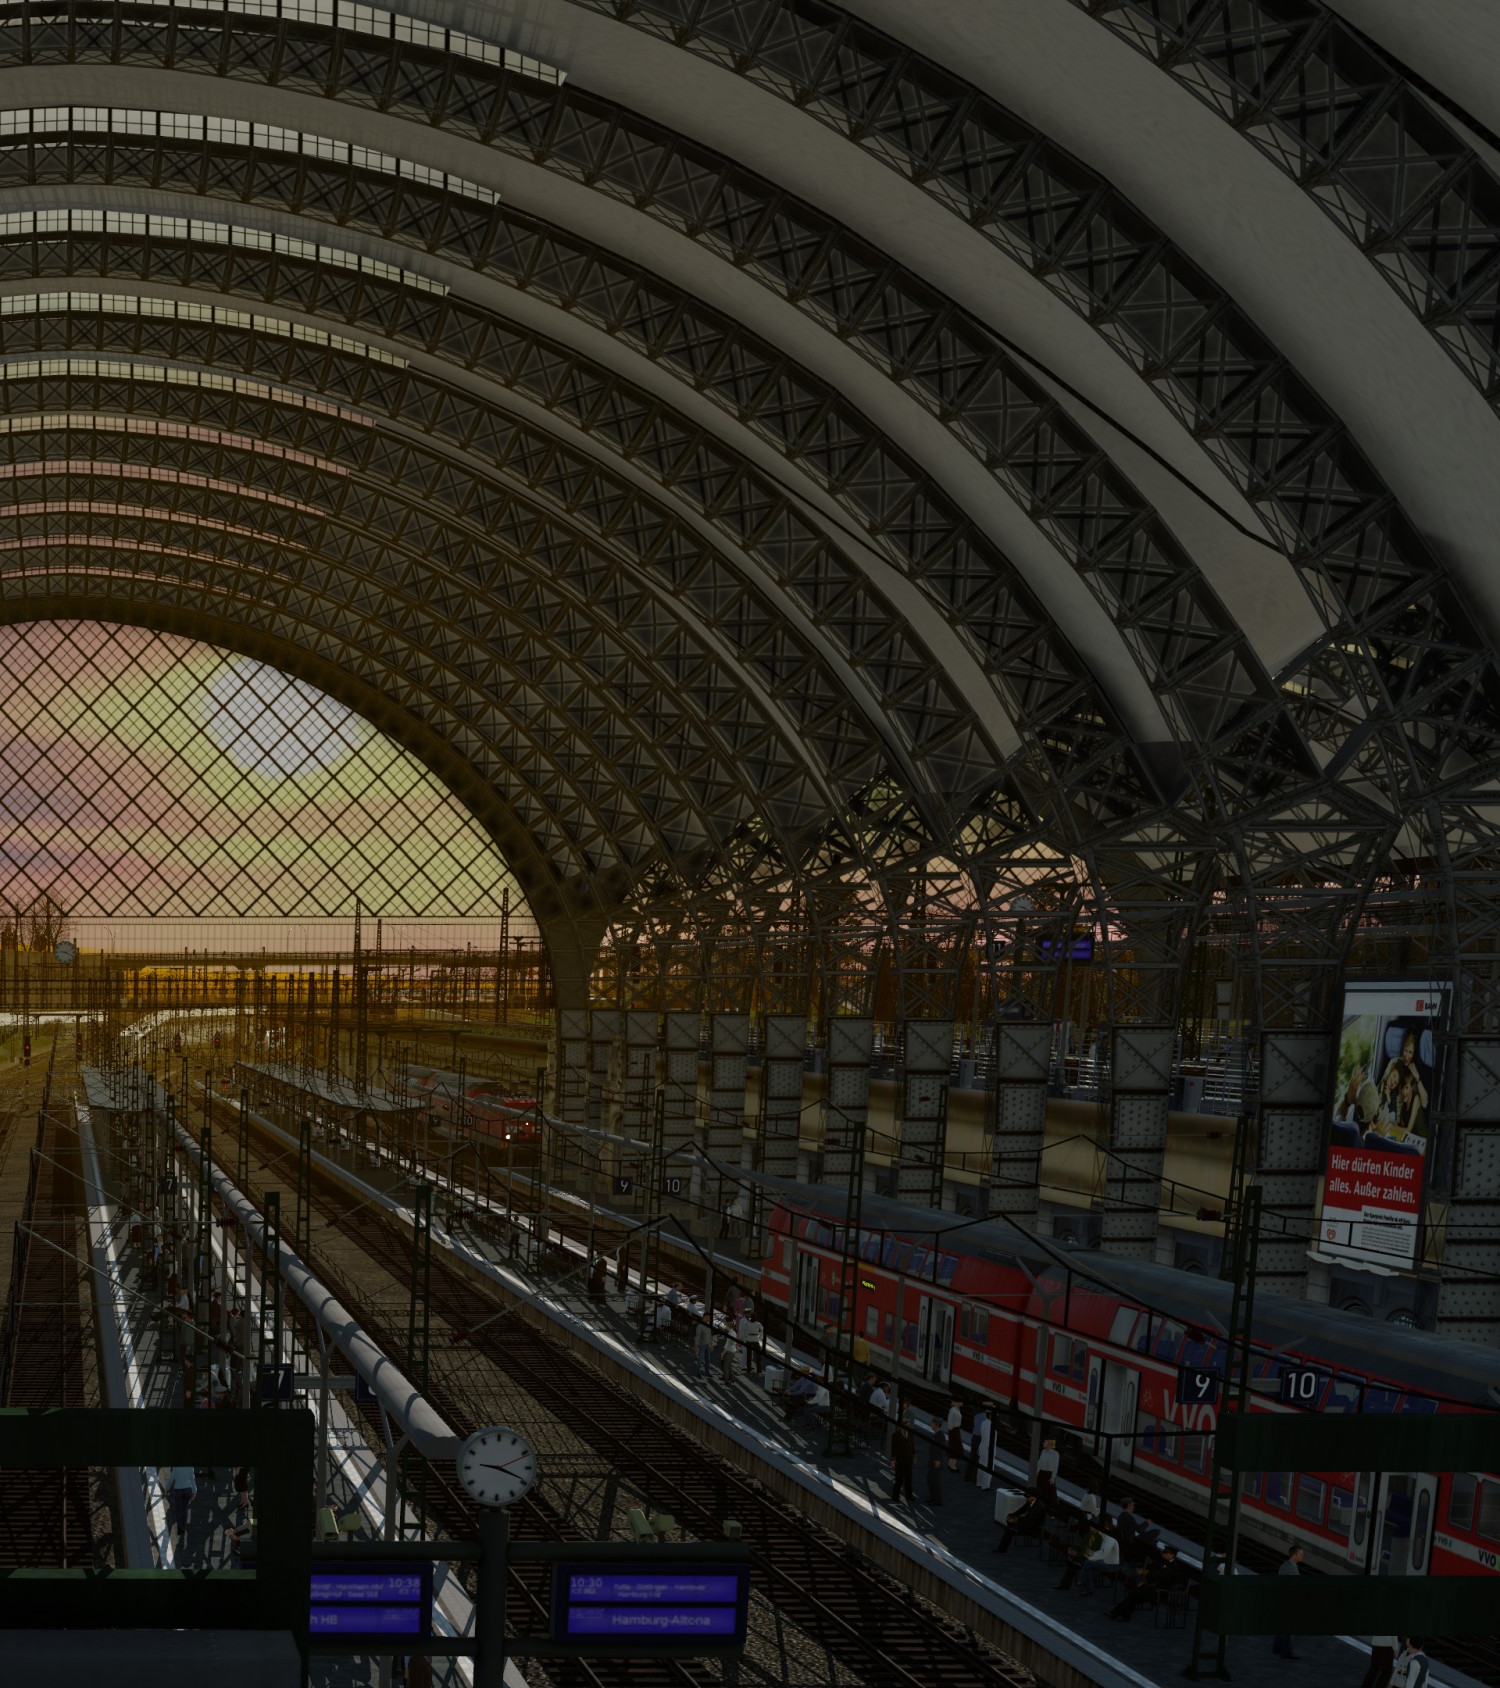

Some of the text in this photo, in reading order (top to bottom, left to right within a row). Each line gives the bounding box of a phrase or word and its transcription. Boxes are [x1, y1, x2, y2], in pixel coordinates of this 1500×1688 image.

[1332, 1154, 1414, 1179] Hier dürfen Kinder
[620, 1180, 629, 1192] 9
[666, 1180, 680, 1193] 10
[1329, 1177, 1416, 1204] alles. Außer zahlen.
[1195, 1374, 1211, 1398] 9
[1288, 1372, 1317, 1399] 10
[1478, 1549, 1497, 1567] VVO
[388, 1577, 420, 1588] 10:38
[570, 1577, 603, 1588] 10:30
[611, 1614, 711, 1629] Hamburg-Altona
